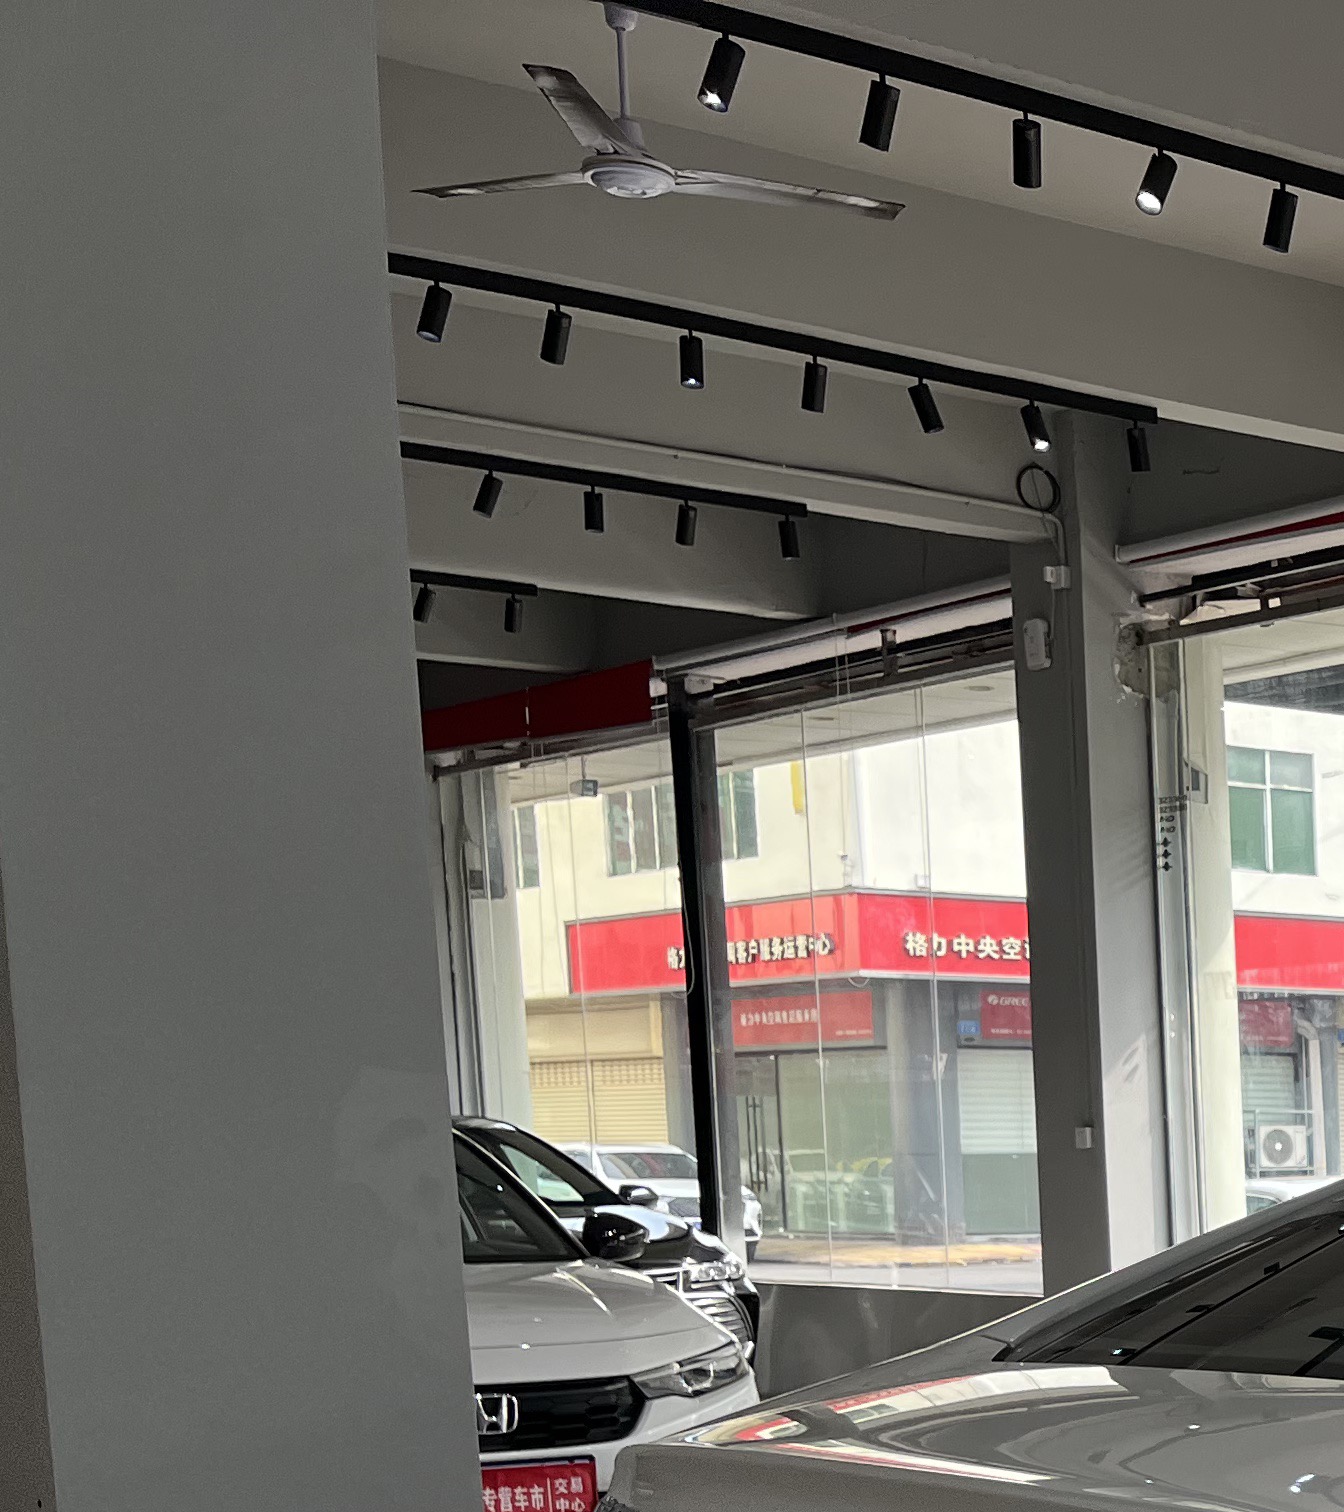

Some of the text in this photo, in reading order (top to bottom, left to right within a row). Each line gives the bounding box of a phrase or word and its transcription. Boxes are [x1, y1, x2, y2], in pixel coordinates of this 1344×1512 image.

[904, 931, 1030, 960] 格力中央空
[554, 1476, 584, 1494] 交易
